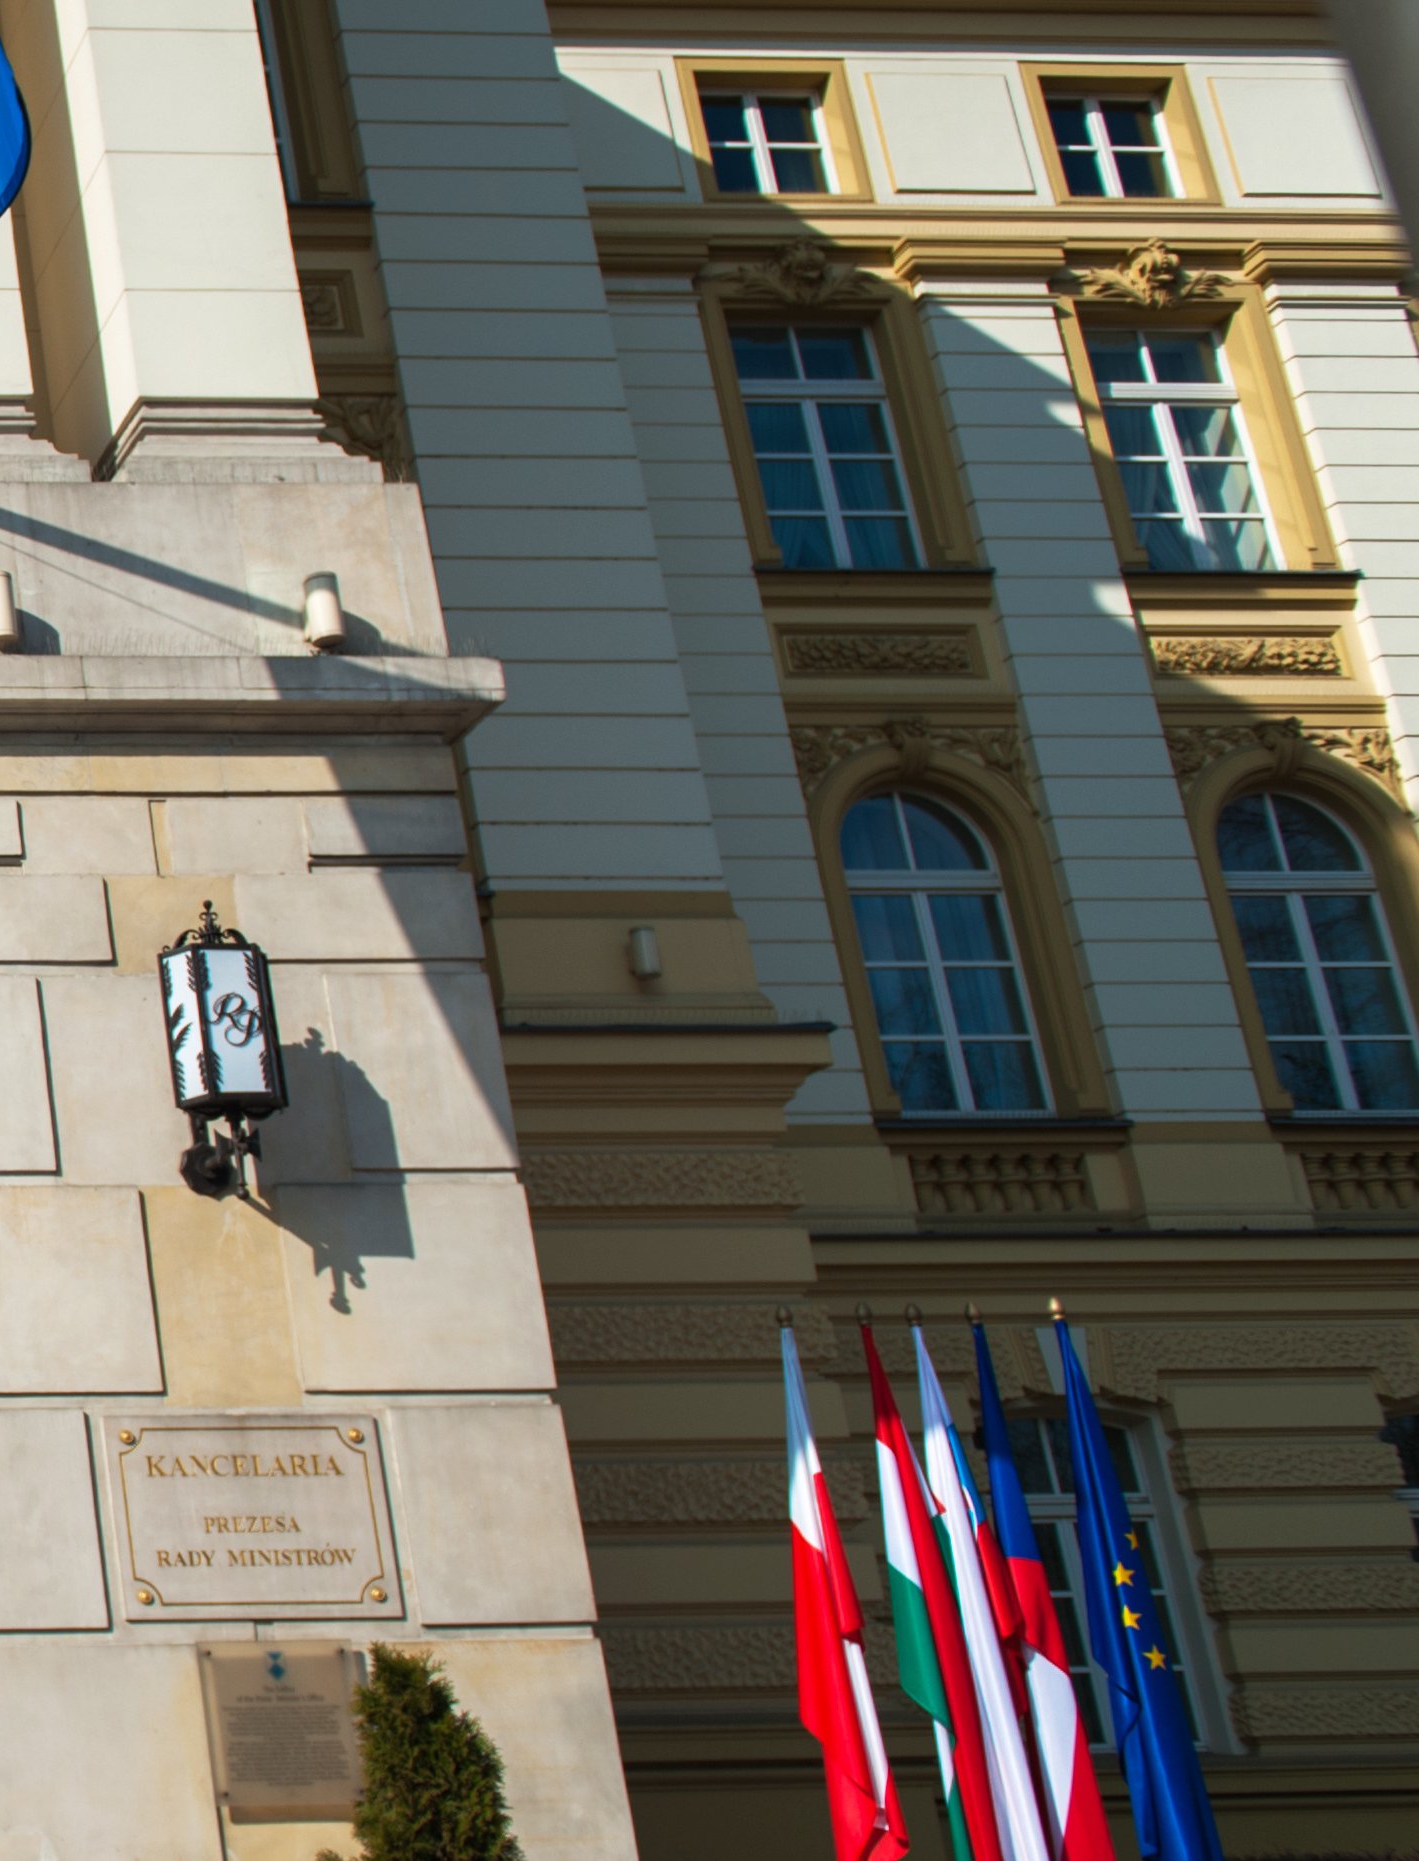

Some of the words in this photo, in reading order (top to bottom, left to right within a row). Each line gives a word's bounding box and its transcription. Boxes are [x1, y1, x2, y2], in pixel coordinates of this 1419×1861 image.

[145, 1453, 345, 1479] KANCELARIA
[203, 1515, 302, 1535] PREZESA
[156, 1549, 216, 1568] RADY
[227, 1542, 358, 1568] MINISTRÓW
